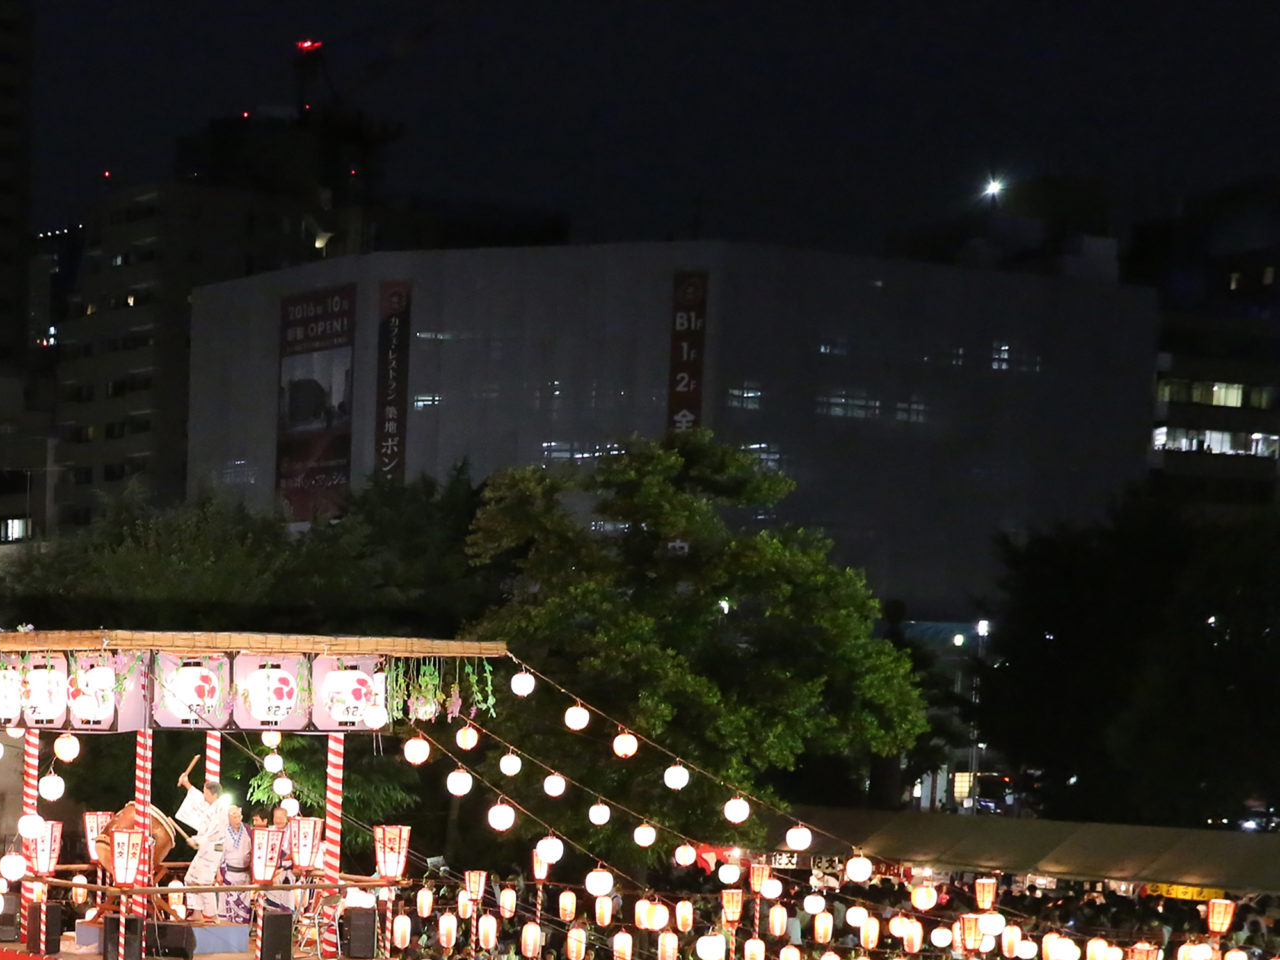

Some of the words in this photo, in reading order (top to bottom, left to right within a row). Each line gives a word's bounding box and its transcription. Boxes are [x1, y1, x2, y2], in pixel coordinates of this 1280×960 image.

[308, 319, 348, 336] OPEN!
[675, 311, 703, 331] B1F
[680, 341, 697, 361] 1F
[675, 372, 697, 393] 2F
